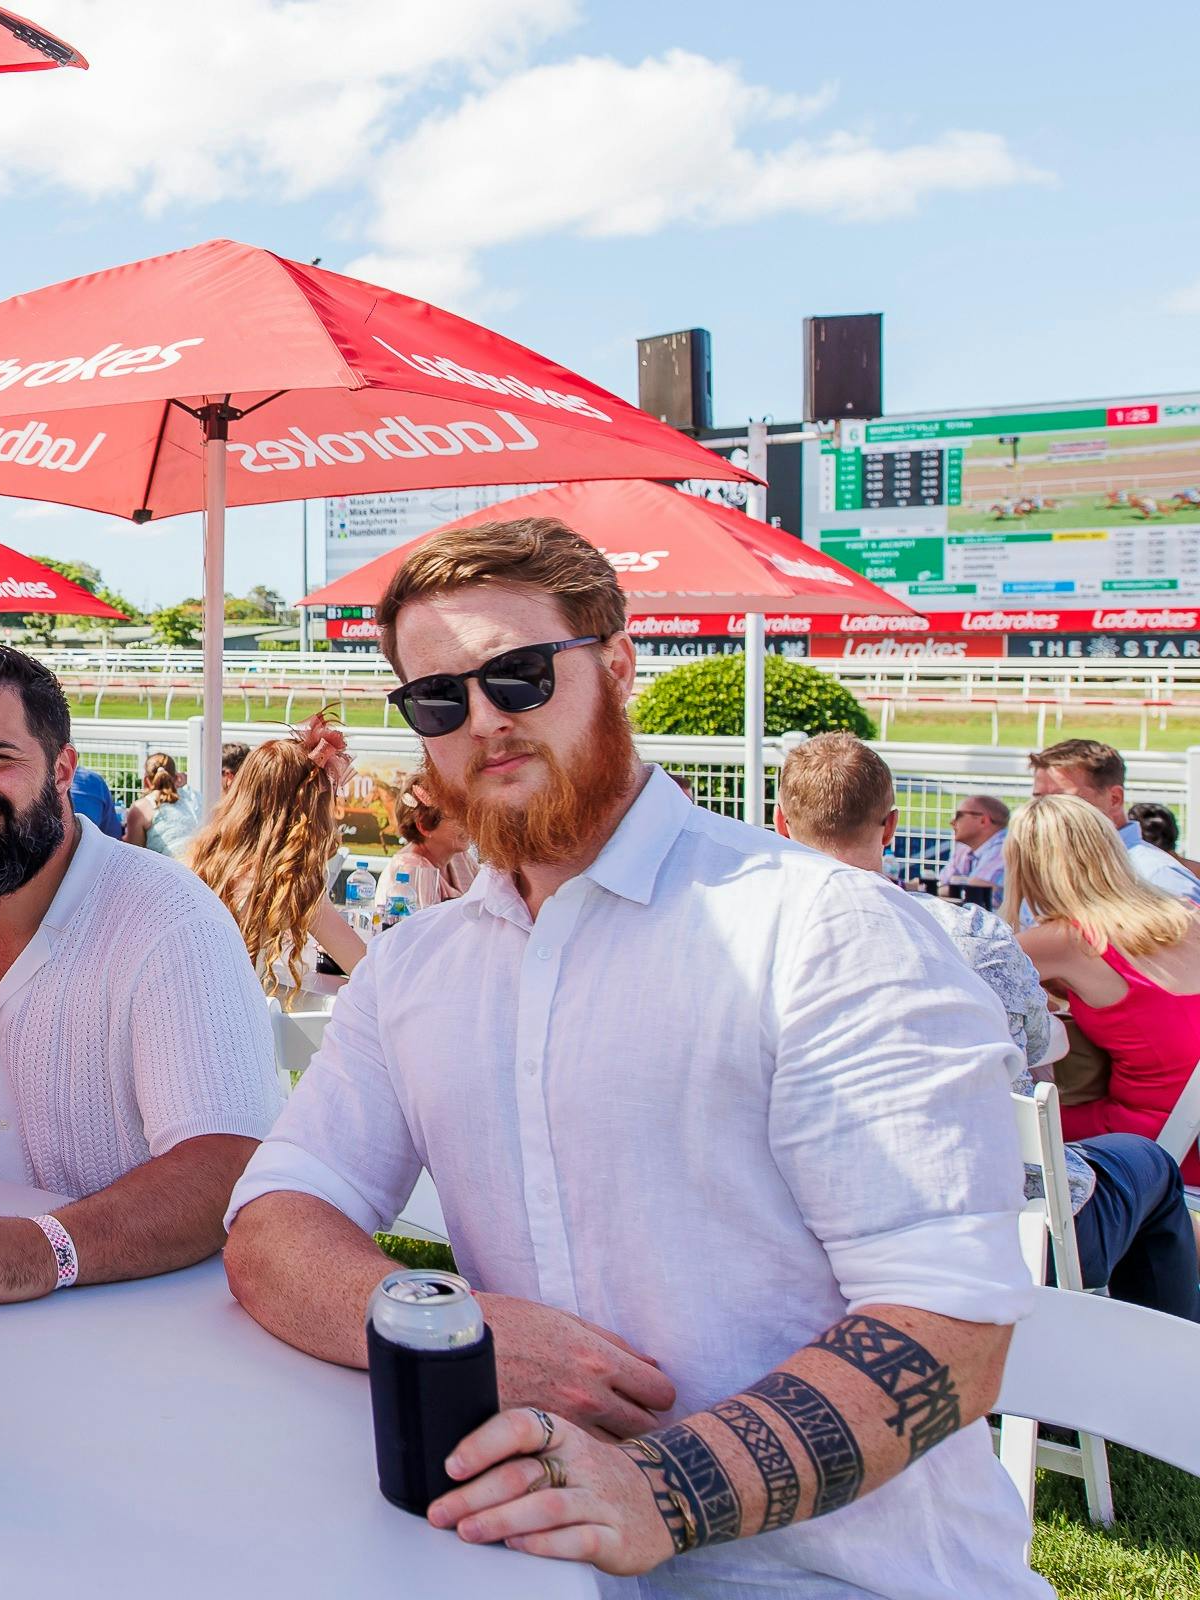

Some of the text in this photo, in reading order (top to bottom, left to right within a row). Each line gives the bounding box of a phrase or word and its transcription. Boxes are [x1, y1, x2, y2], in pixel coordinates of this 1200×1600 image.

[726, 614, 813, 633] Larokes
[839, 614, 930, 632] Ladbrokes
[961, 611, 1059, 631] Ladbrokes
[1091, 609, 1198, 630] Ladbrokes
[659, 643, 717, 657] EAGLE
[842, 638, 968, 658] Ladbrokes
[1028, 640, 1200, 657] THE STAR
